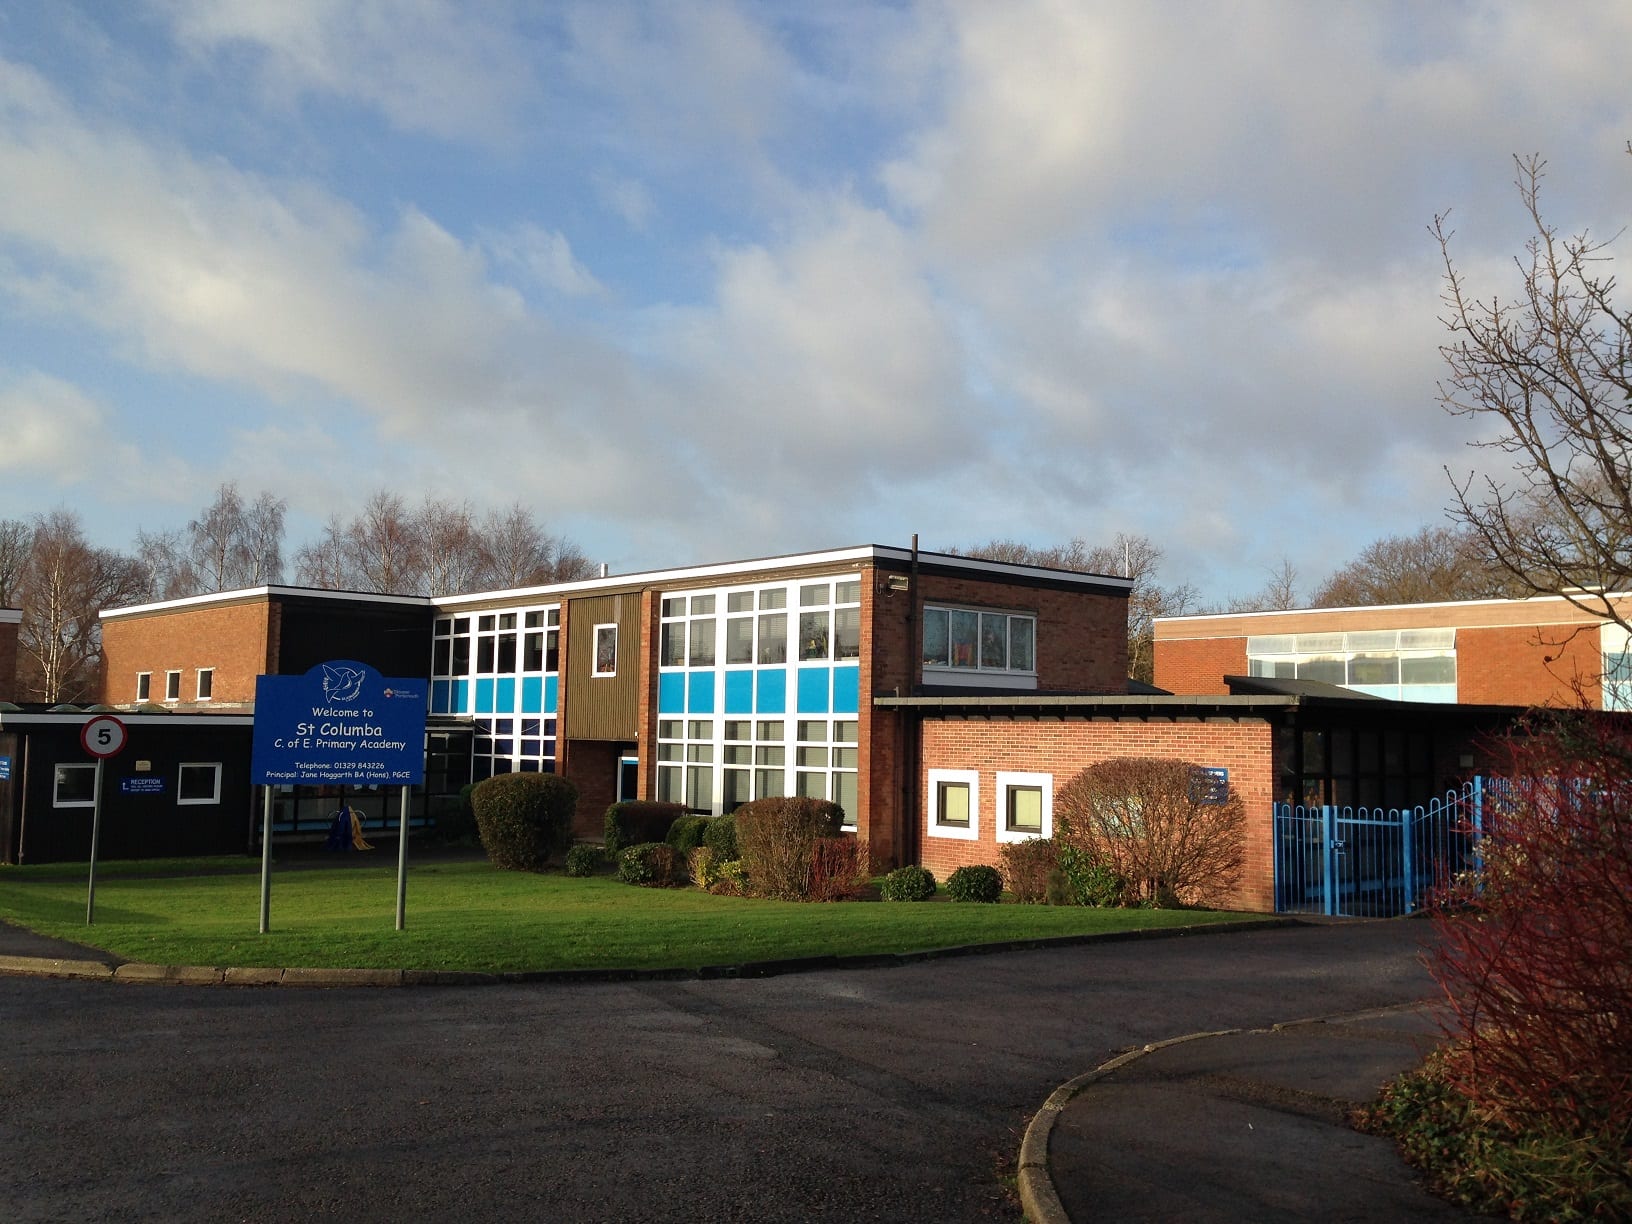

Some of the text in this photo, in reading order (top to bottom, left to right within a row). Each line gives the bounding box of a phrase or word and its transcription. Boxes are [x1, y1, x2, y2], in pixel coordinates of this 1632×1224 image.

[312, 707, 374, 717] Welcome to
[296, 722, 382, 737] St Columba
[98, 728, 112, 745] 5
[274, 738, 406, 751] C. of E. Primary Academy
[357, 762, 385, 770] 843226
[392, 771, 411, 779] PGCE
